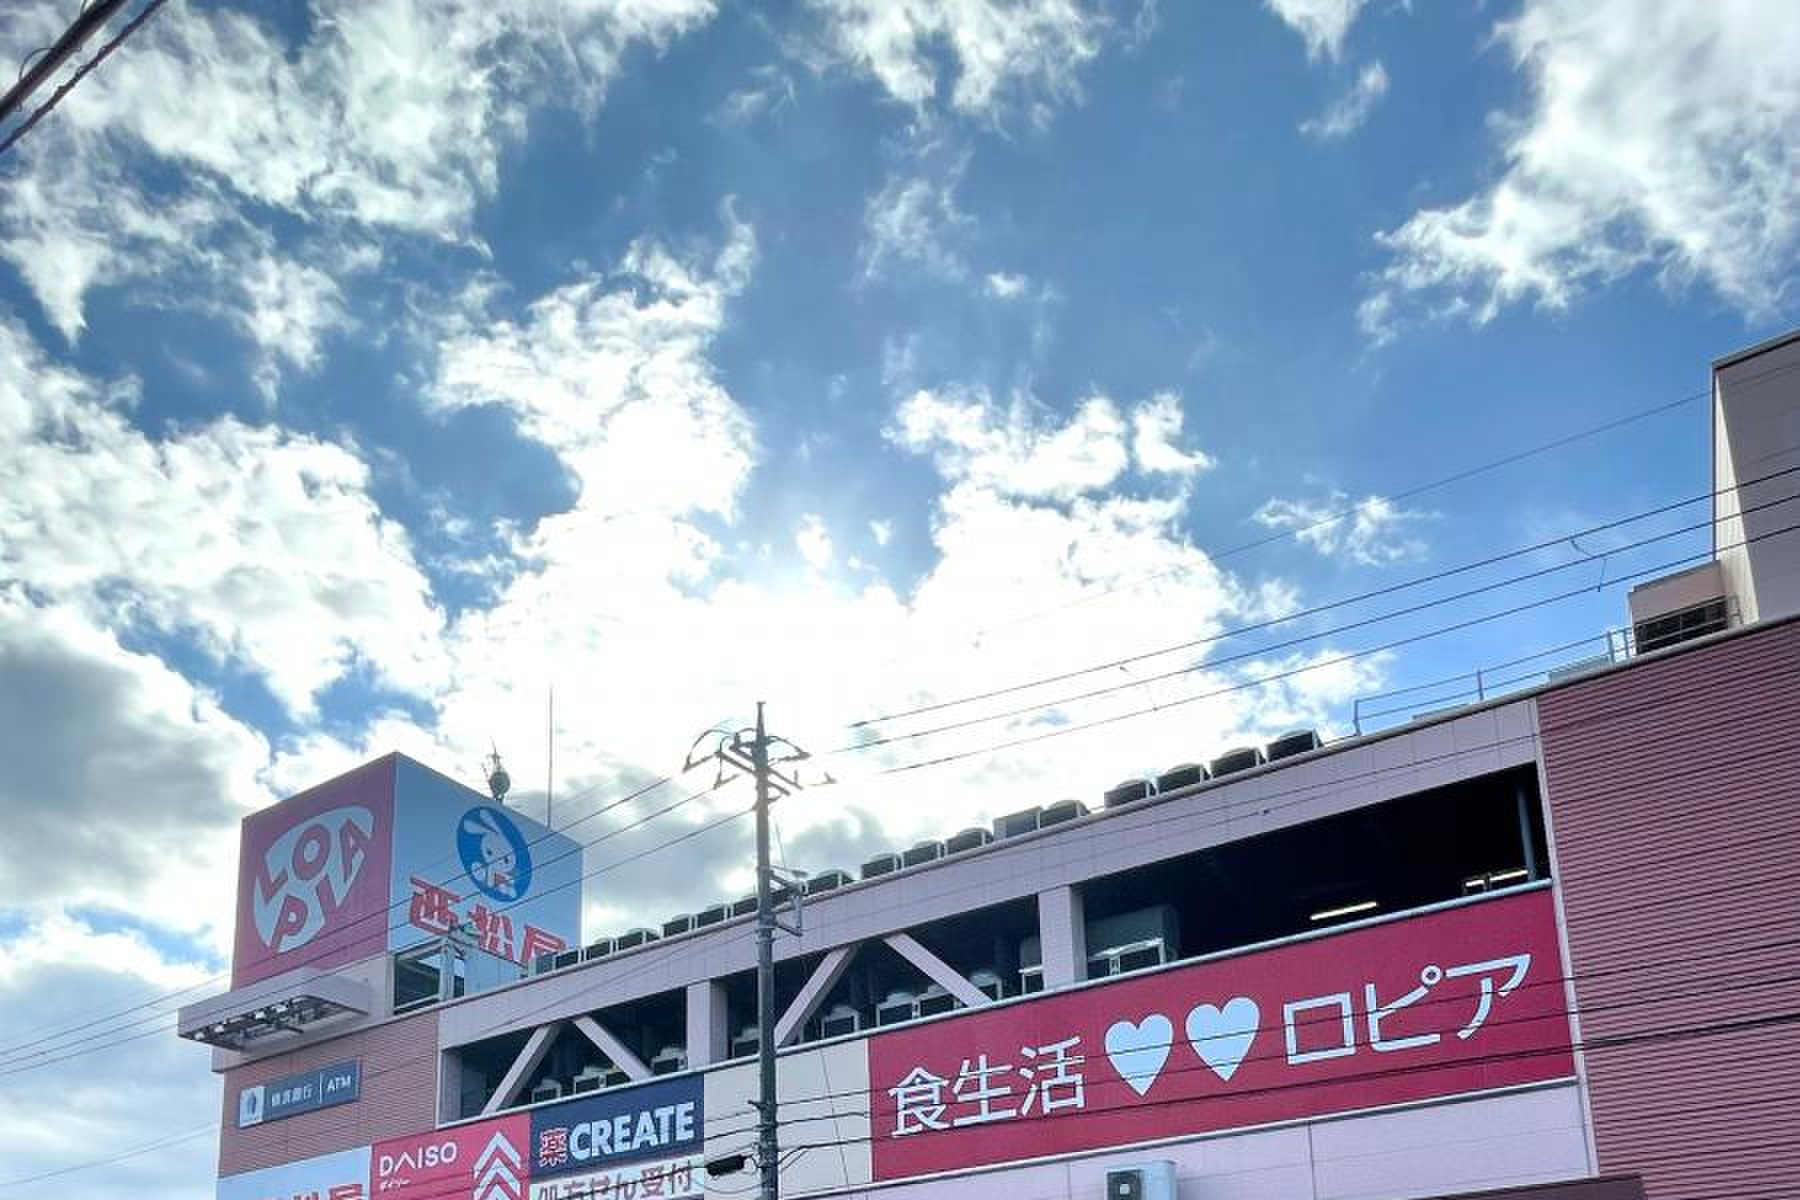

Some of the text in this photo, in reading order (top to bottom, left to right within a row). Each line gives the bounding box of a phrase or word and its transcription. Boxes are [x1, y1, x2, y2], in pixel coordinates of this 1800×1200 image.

[254, 806, 376, 954] LOPIA
[888, 952, 1531, 1138] 食生活 ロピア
[328, 1074, 352, 1093] ATM
[379, 1142, 458, 1177] DAISO
[569, 1101, 695, 1161] CREATE
